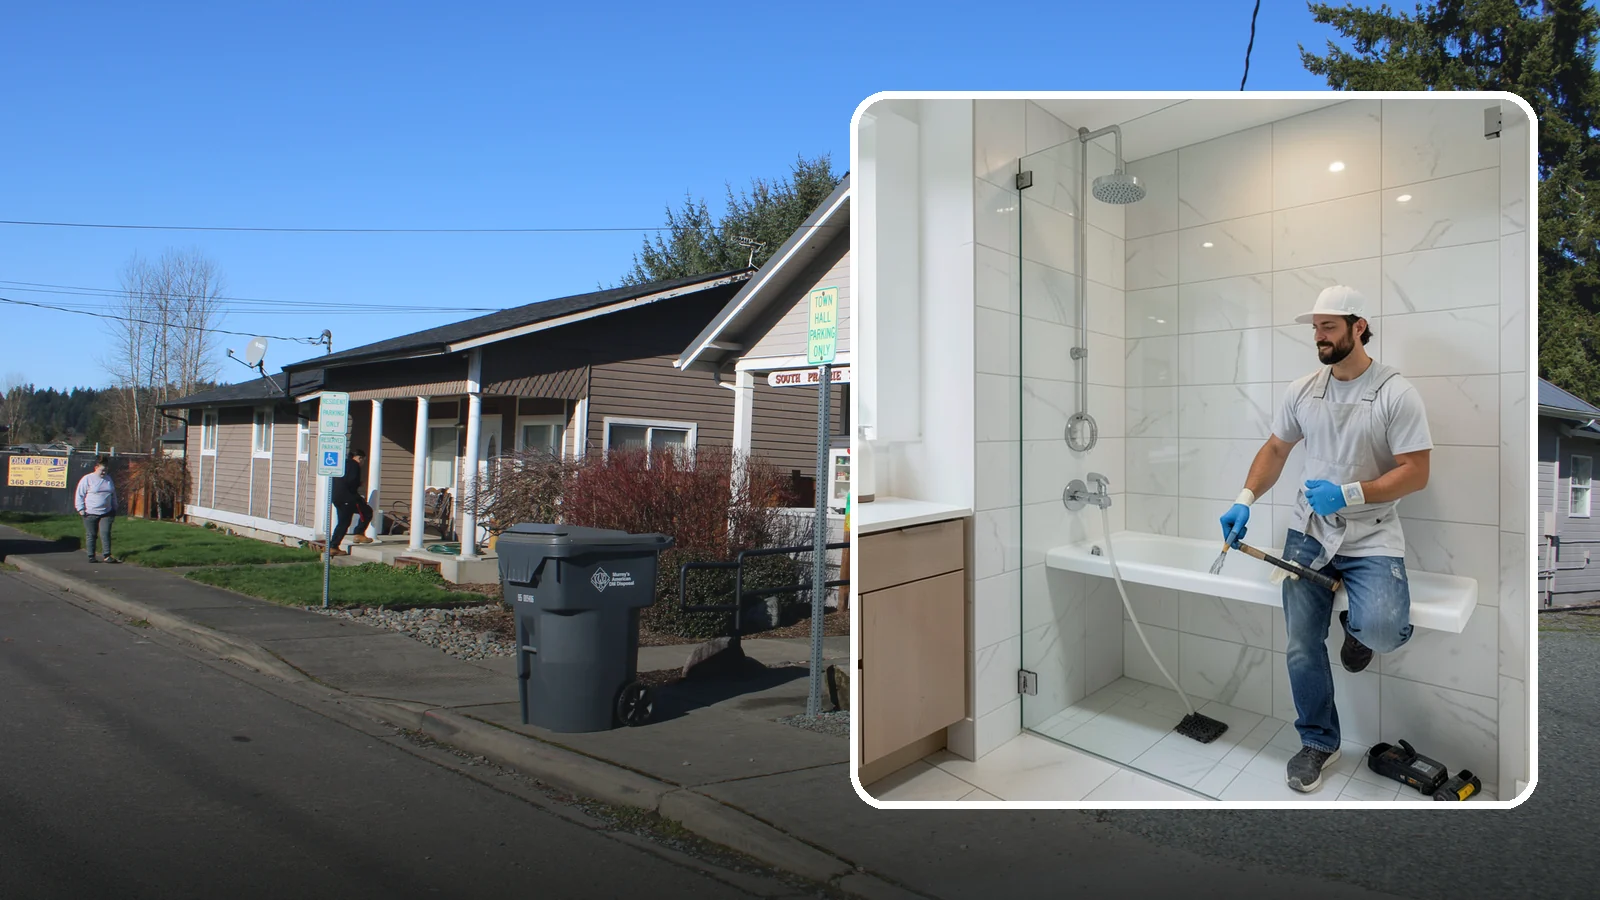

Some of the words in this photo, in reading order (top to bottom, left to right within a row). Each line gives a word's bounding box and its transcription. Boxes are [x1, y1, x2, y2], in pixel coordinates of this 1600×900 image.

[815, 294, 833, 308] TOWN
[814, 312, 831, 325] HALL
[809, 326, 836, 341] PARKING
[813, 344, 831, 358] ONLY
[775, 373, 801, 384] SOUTH
[323, 409, 345, 417] PARKING
[325, 420, 340, 428] ONLY
